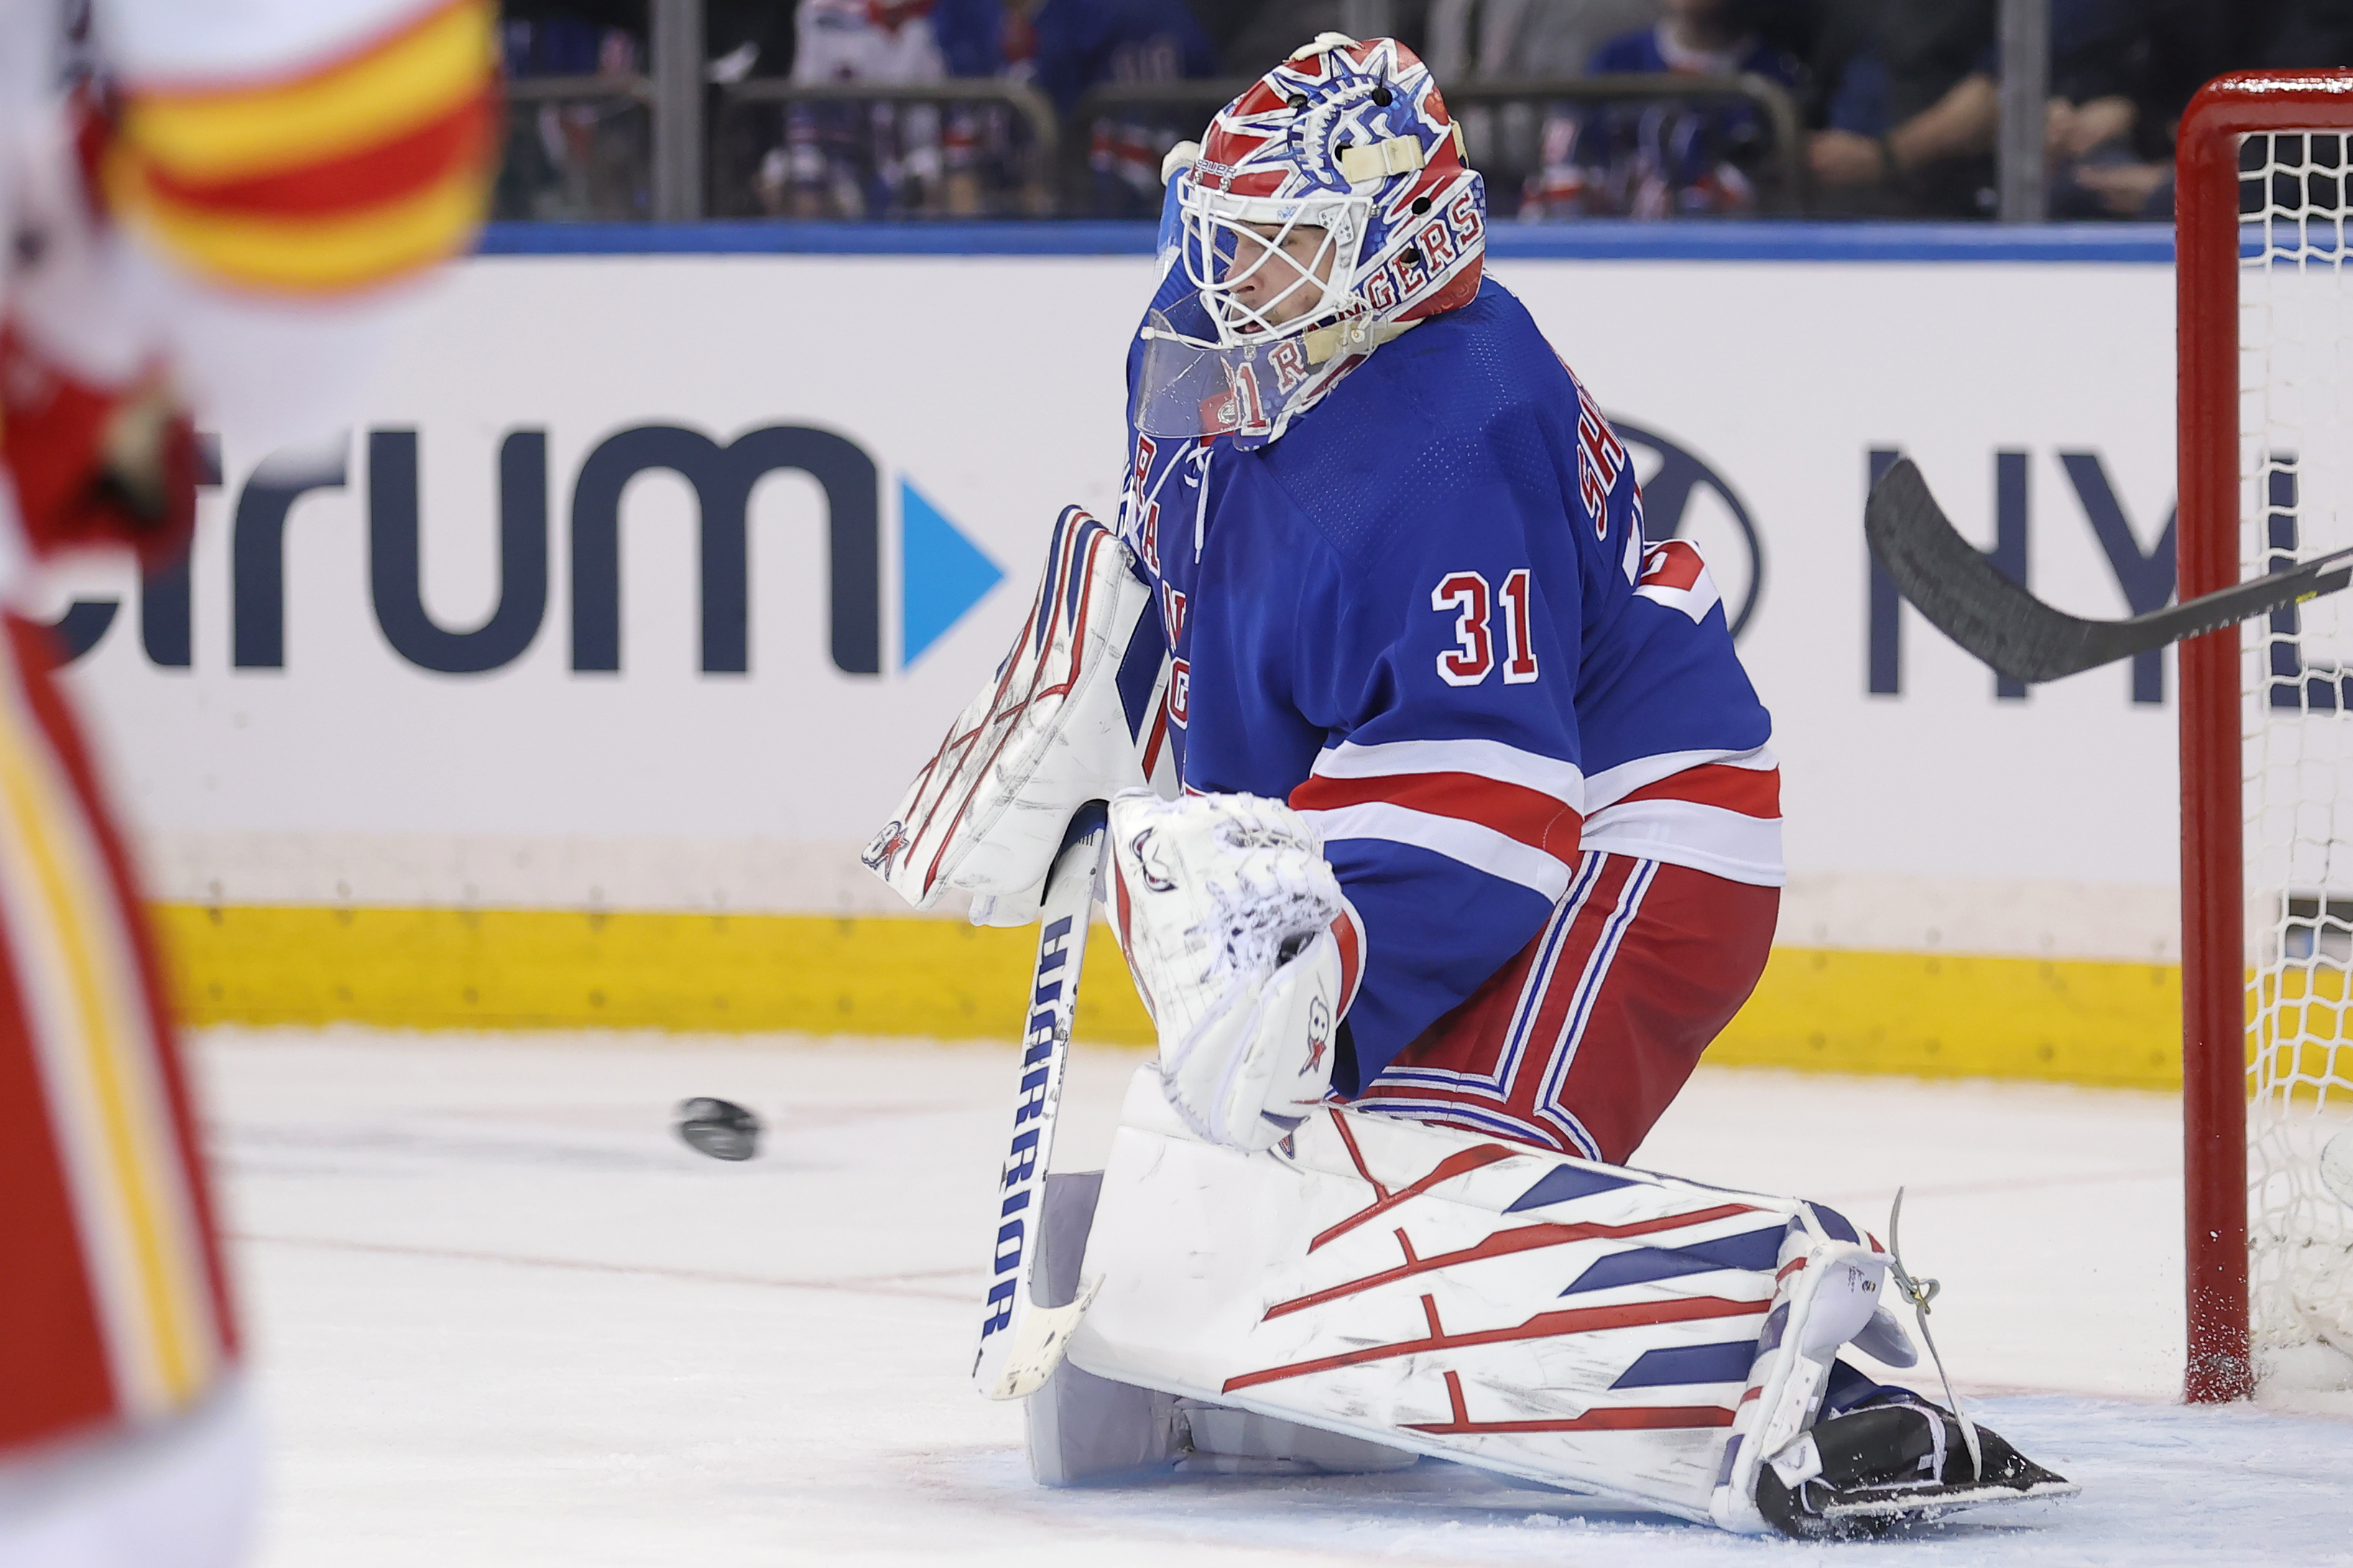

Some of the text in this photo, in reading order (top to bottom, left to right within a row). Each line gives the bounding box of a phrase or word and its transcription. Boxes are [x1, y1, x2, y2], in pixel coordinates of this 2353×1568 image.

[1577, 389, 1625, 542] SH
[1134, 431, 1191, 730] RANG
[1432, 569, 1538, 687] 31
[981, 914, 1073, 1340] WARRIOR
